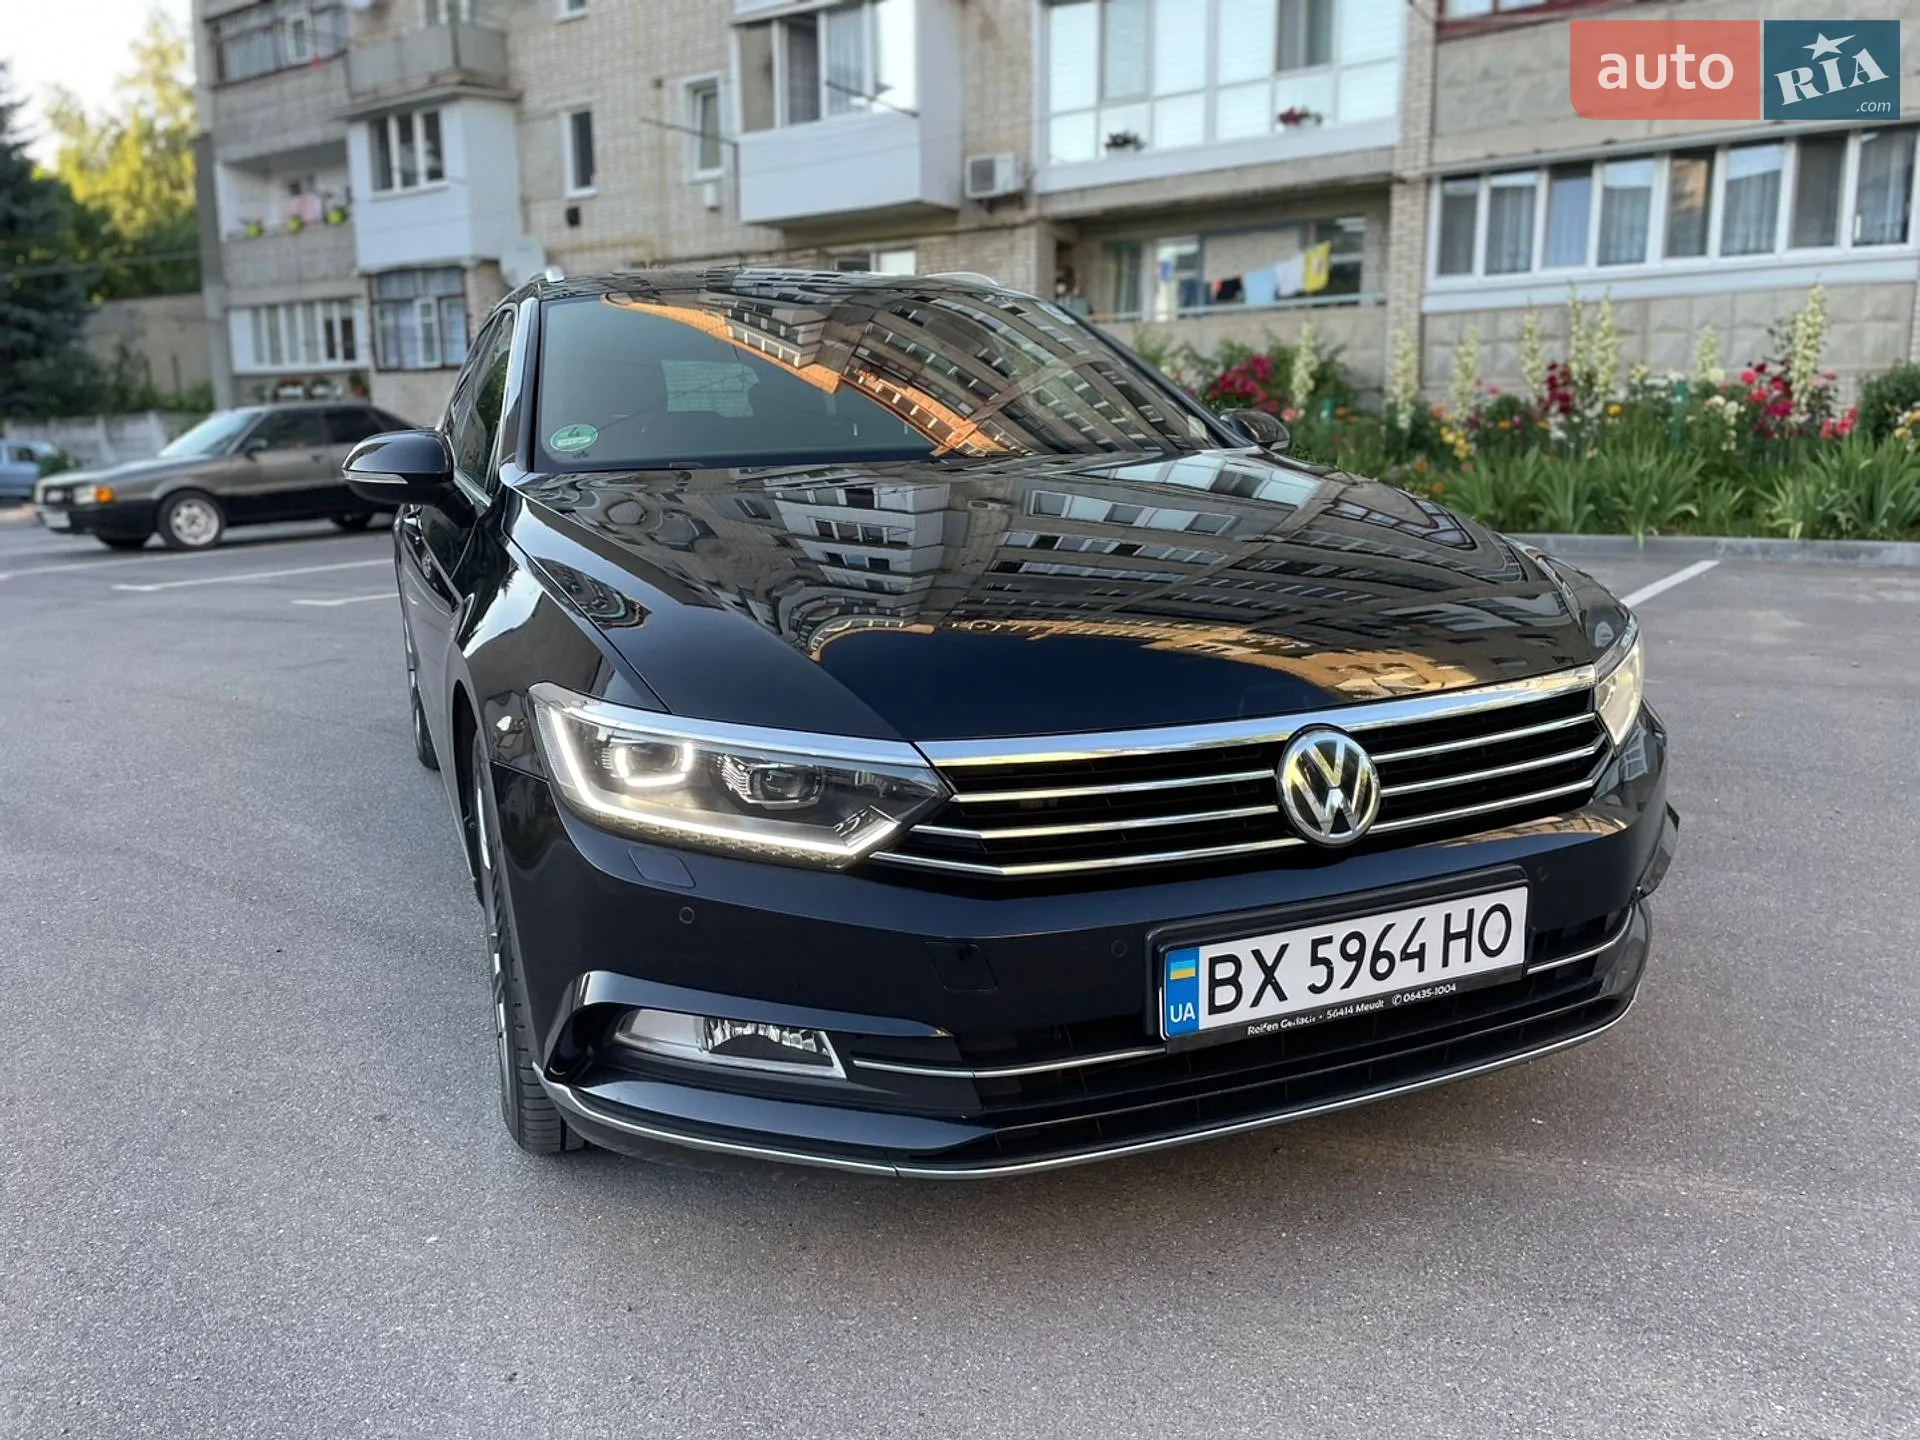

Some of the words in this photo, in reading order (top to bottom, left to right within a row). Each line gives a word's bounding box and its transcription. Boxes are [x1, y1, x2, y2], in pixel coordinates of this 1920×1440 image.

[1282, 731, 1376, 844] VW
[1207, 942, 1290, 1016] BX
[1307, 916, 1427, 995] 5964
[1441, 902, 1513, 969] HO
[1169, 1001, 1196, 1023] UA
[1326, 1004, 1354, 1020] 56414
